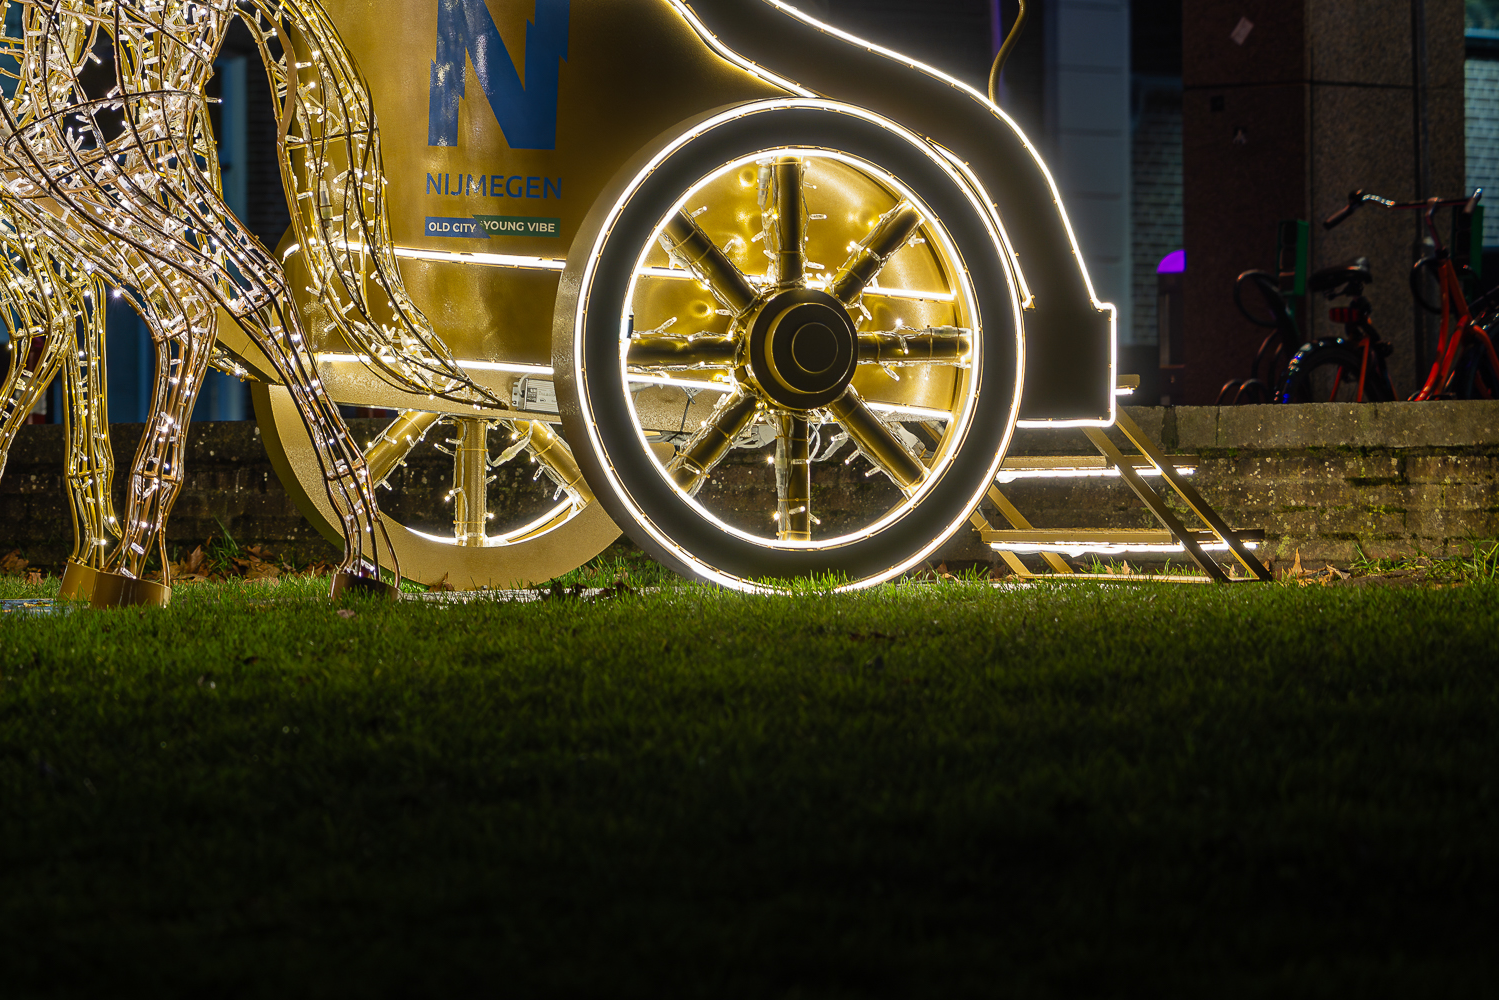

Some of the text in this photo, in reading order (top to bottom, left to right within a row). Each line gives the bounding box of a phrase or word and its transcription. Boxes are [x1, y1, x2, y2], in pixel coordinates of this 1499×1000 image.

[426, 173, 561, 199] NIJMEGEN
[429, 220, 555, 232] OLD CITY YOUNG VIBE
